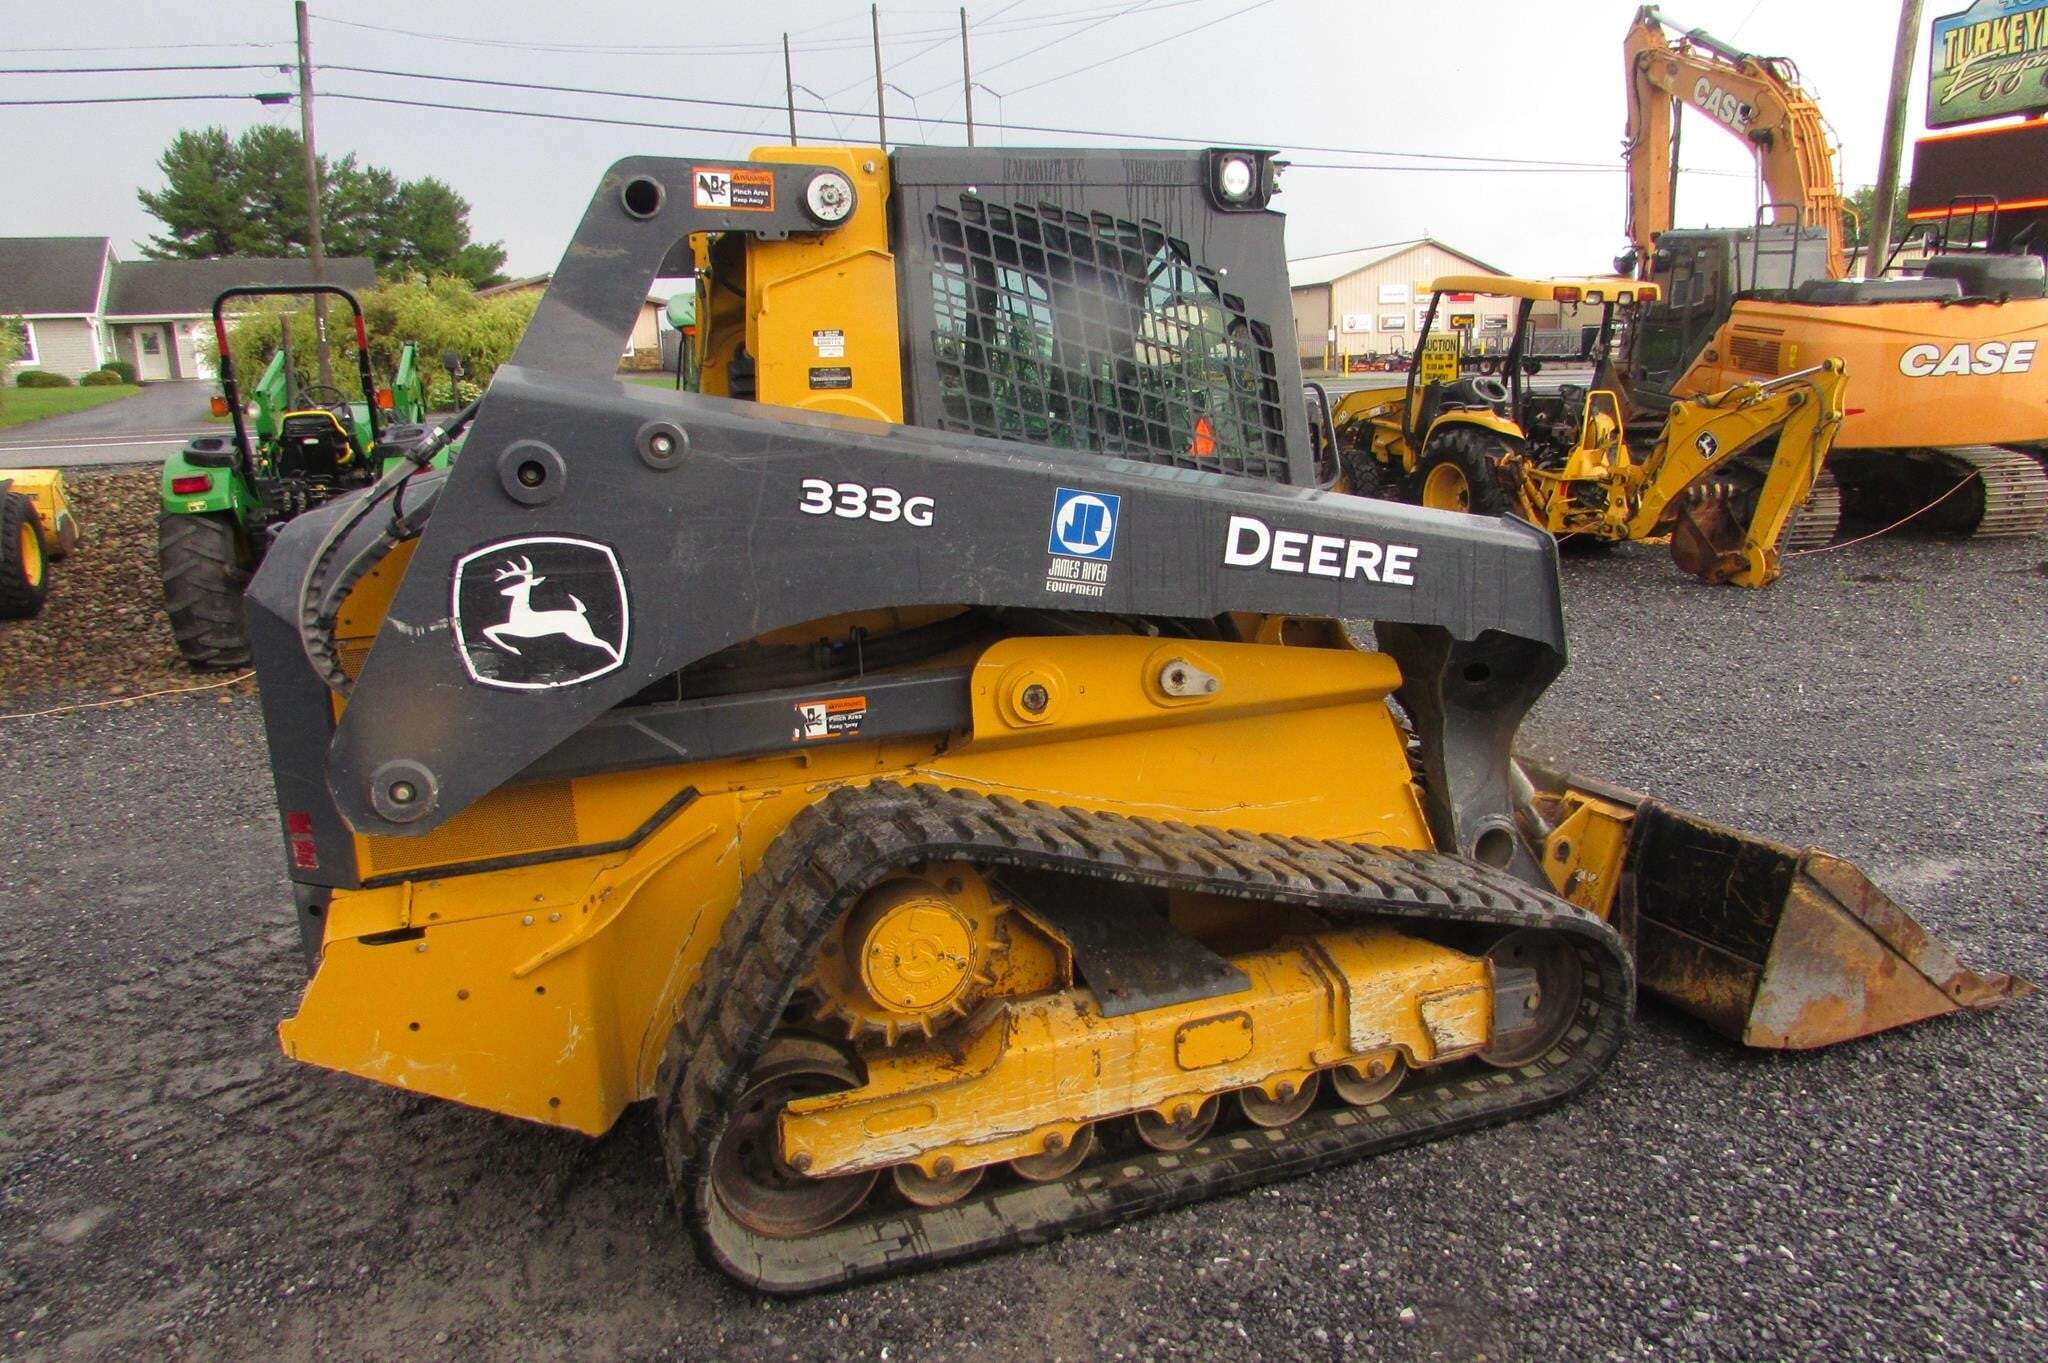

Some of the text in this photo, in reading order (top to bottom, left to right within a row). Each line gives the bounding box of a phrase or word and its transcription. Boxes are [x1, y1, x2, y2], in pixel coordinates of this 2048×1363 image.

[1694, 77, 1749, 133] CASE
[1424, 339, 1456, 351] UCTION
[1899, 341, 2038, 377] CASE
[800, 479, 935, 526] 333G
[1224, 515, 1419, 586] DEERE
[1048, 558, 1108, 582] JAMES RIVER
[1046, 581, 1104, 597] EQUIPMENT
